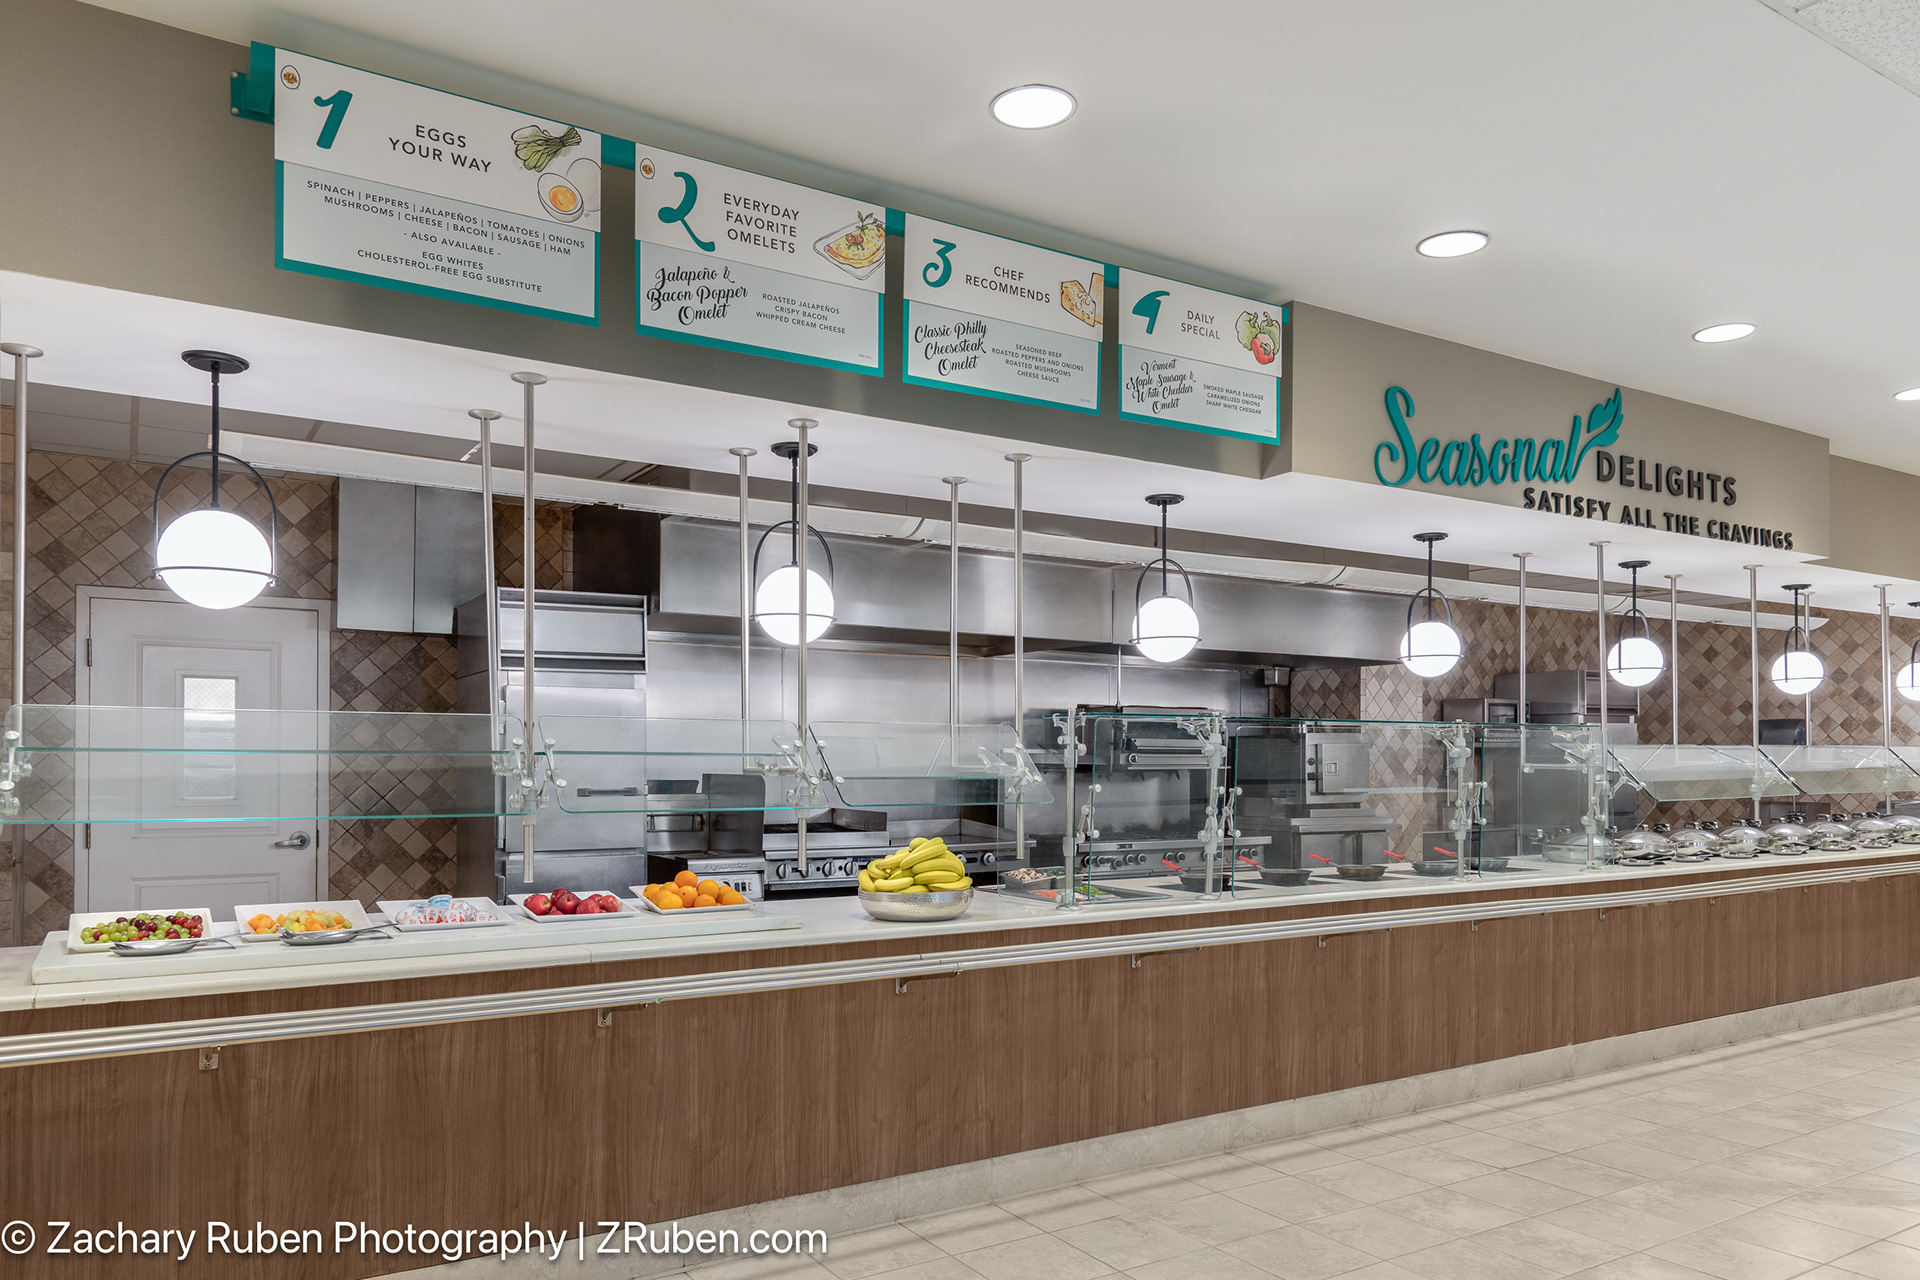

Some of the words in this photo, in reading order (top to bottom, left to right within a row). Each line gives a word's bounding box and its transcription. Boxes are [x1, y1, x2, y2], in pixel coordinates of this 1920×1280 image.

[314, 90, 353, 149] 1
[416, 124, 466, 148] EGGS
[388, 137, 442, 162] YOUR
[450, 152, 491, 173] WAY
[307, 180, 354, 197] SPINACH
[365, 193, 409, 210] PEPPERS
[419, 206, 478, 225] JALAPEÑOS
[487, 220, 540, 238] TOMATOES
[548, 234, 585, 248] ONIONS
[658, 172, 715, 251] 2
[724, 193, 800, 221] EVERYDAY
[324, 195, 394, 217] MUSHROOMS
[404, 213, 443, 228] CHEESE
[453, 223, 488, 238] BACON
[497, 233, 541, 249] SAUSAGE
[550, 245, 571, 255] HAM
[726, 210, 797, 238] FAVORITE
[411, 231, 438, 243] ALSO
[441, 238, 494, 256] AVAILABLE
[727, 228, 795, 254] OMELETS
[357, 249, 459, 276] CHOLESTEROL-FREE
[462, 270, 483, 281] EGG
[486, 275, 542, 293] SUBSTITUTE
[422, 251, 443, 262] EGG
[446, 256, 484, 270] WHITES
[923, 239, 956, 287] 3
[655, 266, 718, 289] Jalapeño
[723, 266, 735, 283] &
[994, 266, 1024, 282] CHEF
[647, 288, 692, 311] Bacon
[696, 285, 748, 306] Popper
[966, 274, 1050, 304] RECOMMENDS
[679, 303, 729, 325] Omelet
[762, 293, 797, 306] ROASTED
[798, 301, 840, 315] JALAPEÑOS
[774, 305, 800, 316] CRISPY
[802, 310, 828, 321] BACON
[1132, 291, 1169, 334] 4
[755, 311, 790, 323] WHIPPED
[791, 318, 817, 328] CREAM
[818, 323, 845, 334] CHEESE
[1187, 310, 1215, 325] DAILY
[915, 325, 951, 343] Classic
[954, 321, 988, 339] Philly
[1181, 322, 1220, 340] SPECIAL
[925, 338, 986, 359] Cheesesteak
[992, 347, 1020, 358] ROASTED
[1021, 353, 1046, 364] PEPPERS
[1047, 359, 1060, 367] AND
[1061, 361, 1084, 372] ONIONS
[1015, 344, 1047, 356] SEASONED
[1048, 350, 1062, 358] BEEF
[939, 355, 979, 376] Omelet
[1005, 359, 1033, 370] ROASTED
[1034, 364, 1071, 377] MUSHROOMS
[1016, 369, 1039, 380] CHEESE
[1040, 374, 1059, 384] SAUCE
[1141, 358, 1177, 375] Vermont
[1126, 375, 1153, 391] Maple
[1156, 374, 1186, 389] Sausage
[1132, 387, 1160, 403] White
[1163, 384, 1193, 399] Cheddar
[1203, 384, 1224, 393] SMOKED
[1225, 388, 1241, 396] MAPLE
[1242, 391, 1264, 401] SAUSAGE
[1153, 398, 1180, 414] Omelet
[1205, 399, 1222, 407] SHARP
[1222, 403, 1238, 411] WHITE
[1239, 406, 1262, 414] CHEDDAR
[1206, 392, 1241, 404] CARAMELIZED
[1241, 398, 1261, 408] ONIONS
[1373, 385, 1600, 487] Seasonal
[1596, 449, 1738, 507] DELIGHTS
[1522, 486, 1612, 521] SATISFY
[1619, 504, 1657, 530] ALL
[1662, 512, 1701, 537] THE
[1706, 519, 1795, 552] CRAVINGS
